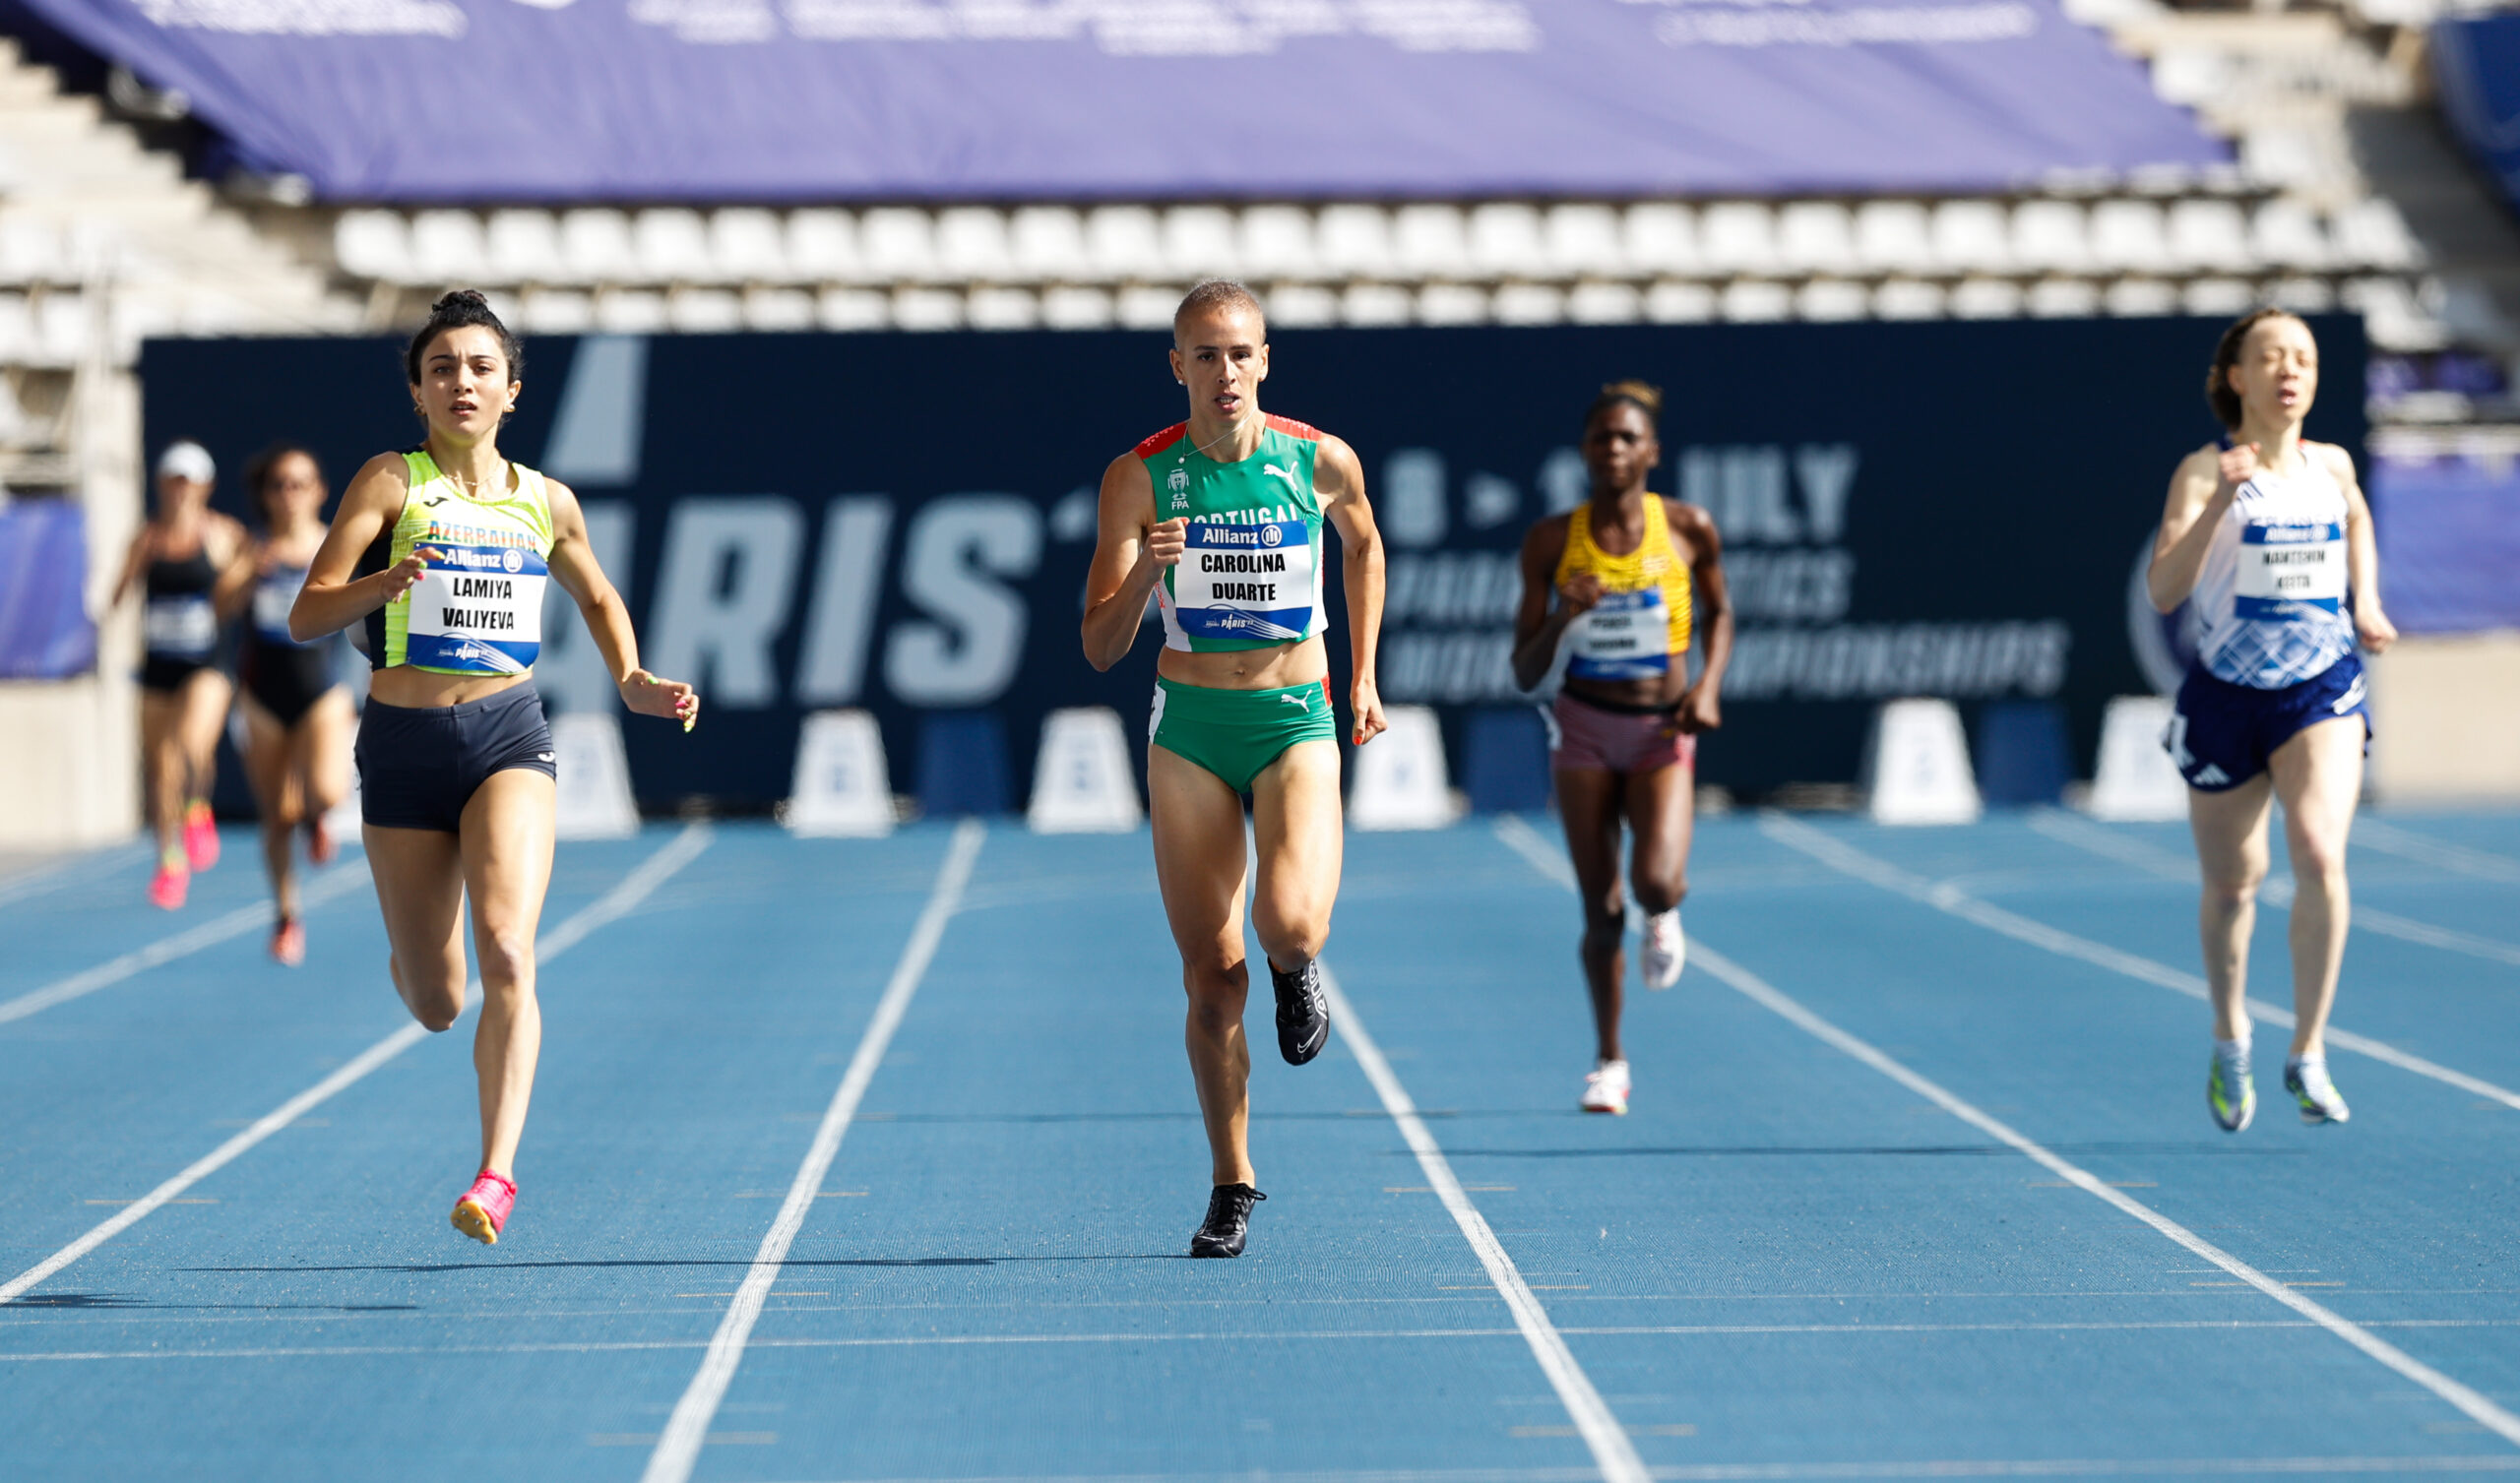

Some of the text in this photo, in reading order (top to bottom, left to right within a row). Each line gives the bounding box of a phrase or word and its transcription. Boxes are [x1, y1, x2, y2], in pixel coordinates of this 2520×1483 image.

[1171, 501, 1189, 511] FPA
[1193, 503, 1298, 525] ORTUGAL
[1202, 528, 1259, 544] Allianz
[444, 548, 501, 568] Allianz
[1201, 553, 1286, 574] CAROLINA
[453, 578, 512, 599] LAMIYA
[1212, 583, 1276, 602] DUARTE
[443, 607, 514, 630] VALIYEVA
